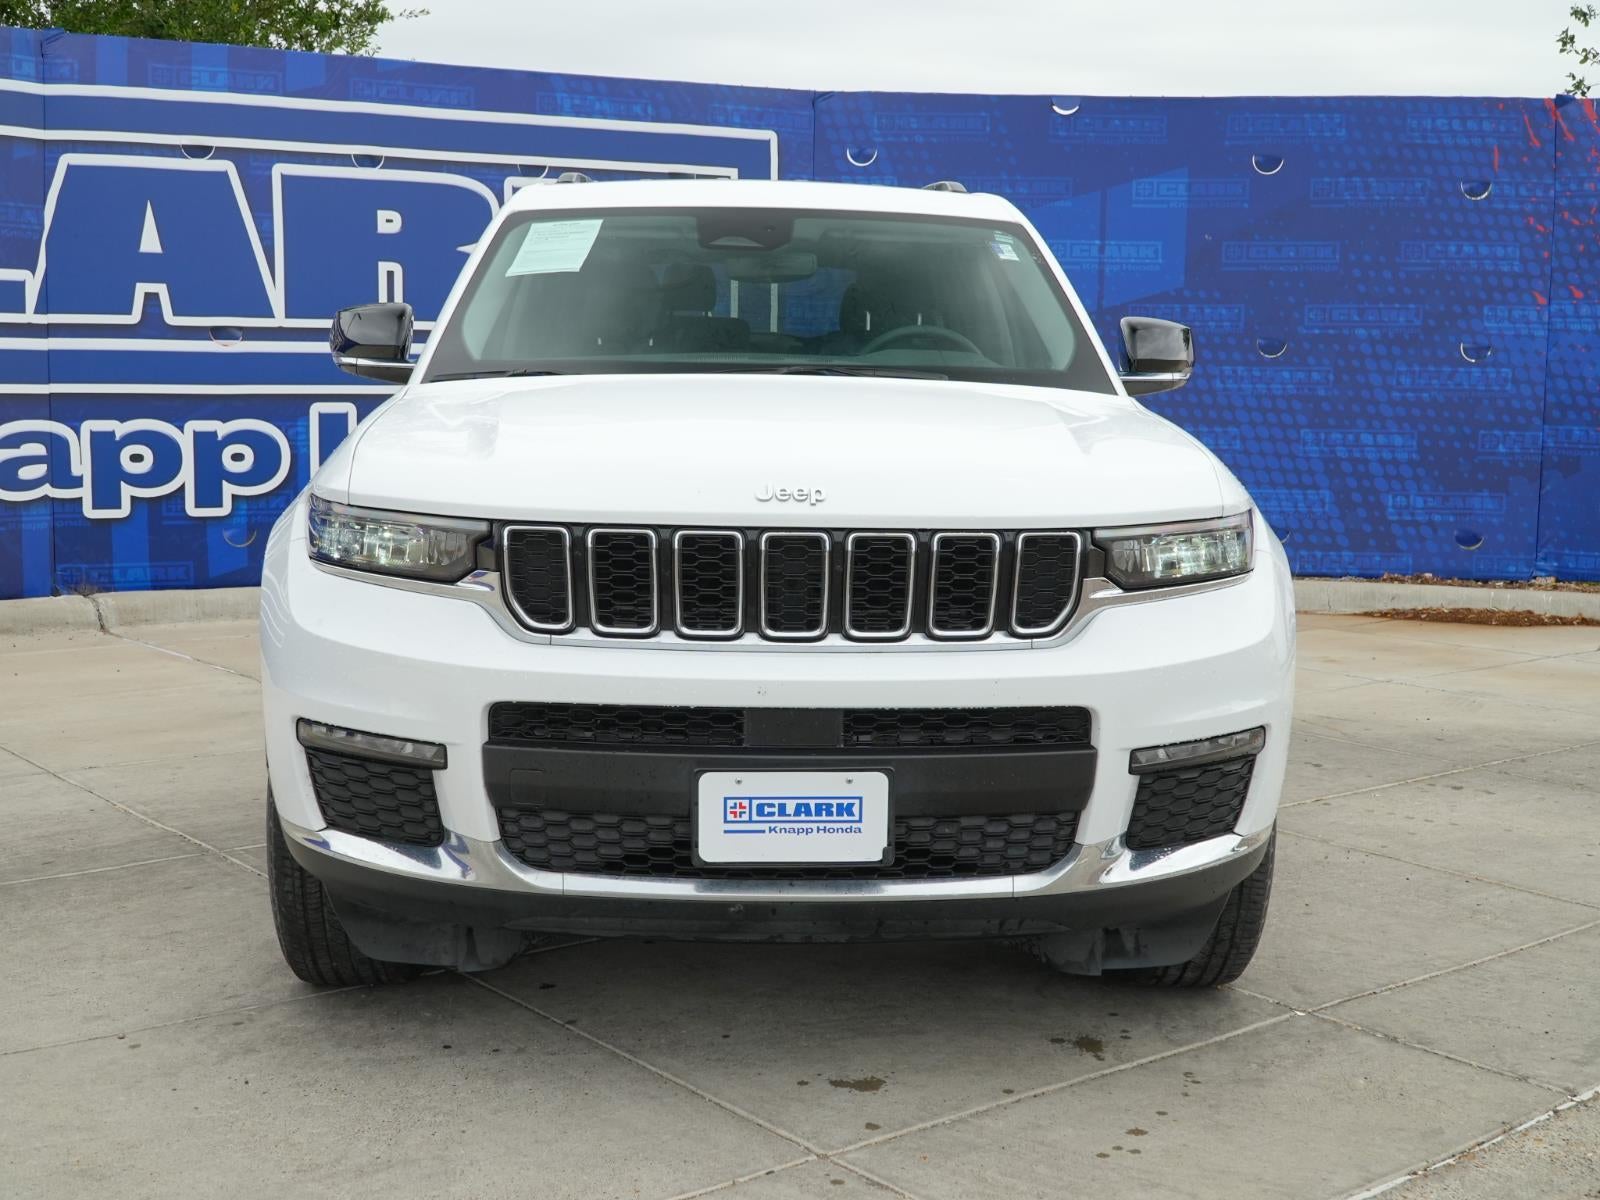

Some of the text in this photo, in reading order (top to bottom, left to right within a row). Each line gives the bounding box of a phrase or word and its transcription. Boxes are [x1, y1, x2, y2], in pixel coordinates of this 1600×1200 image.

[0, 153, 557, 330] AR
[755, 481, 826, 506] Jeep
[756, 802, 856, 817] CLARK
[768, 825, 862, 836] Knapp Honda
